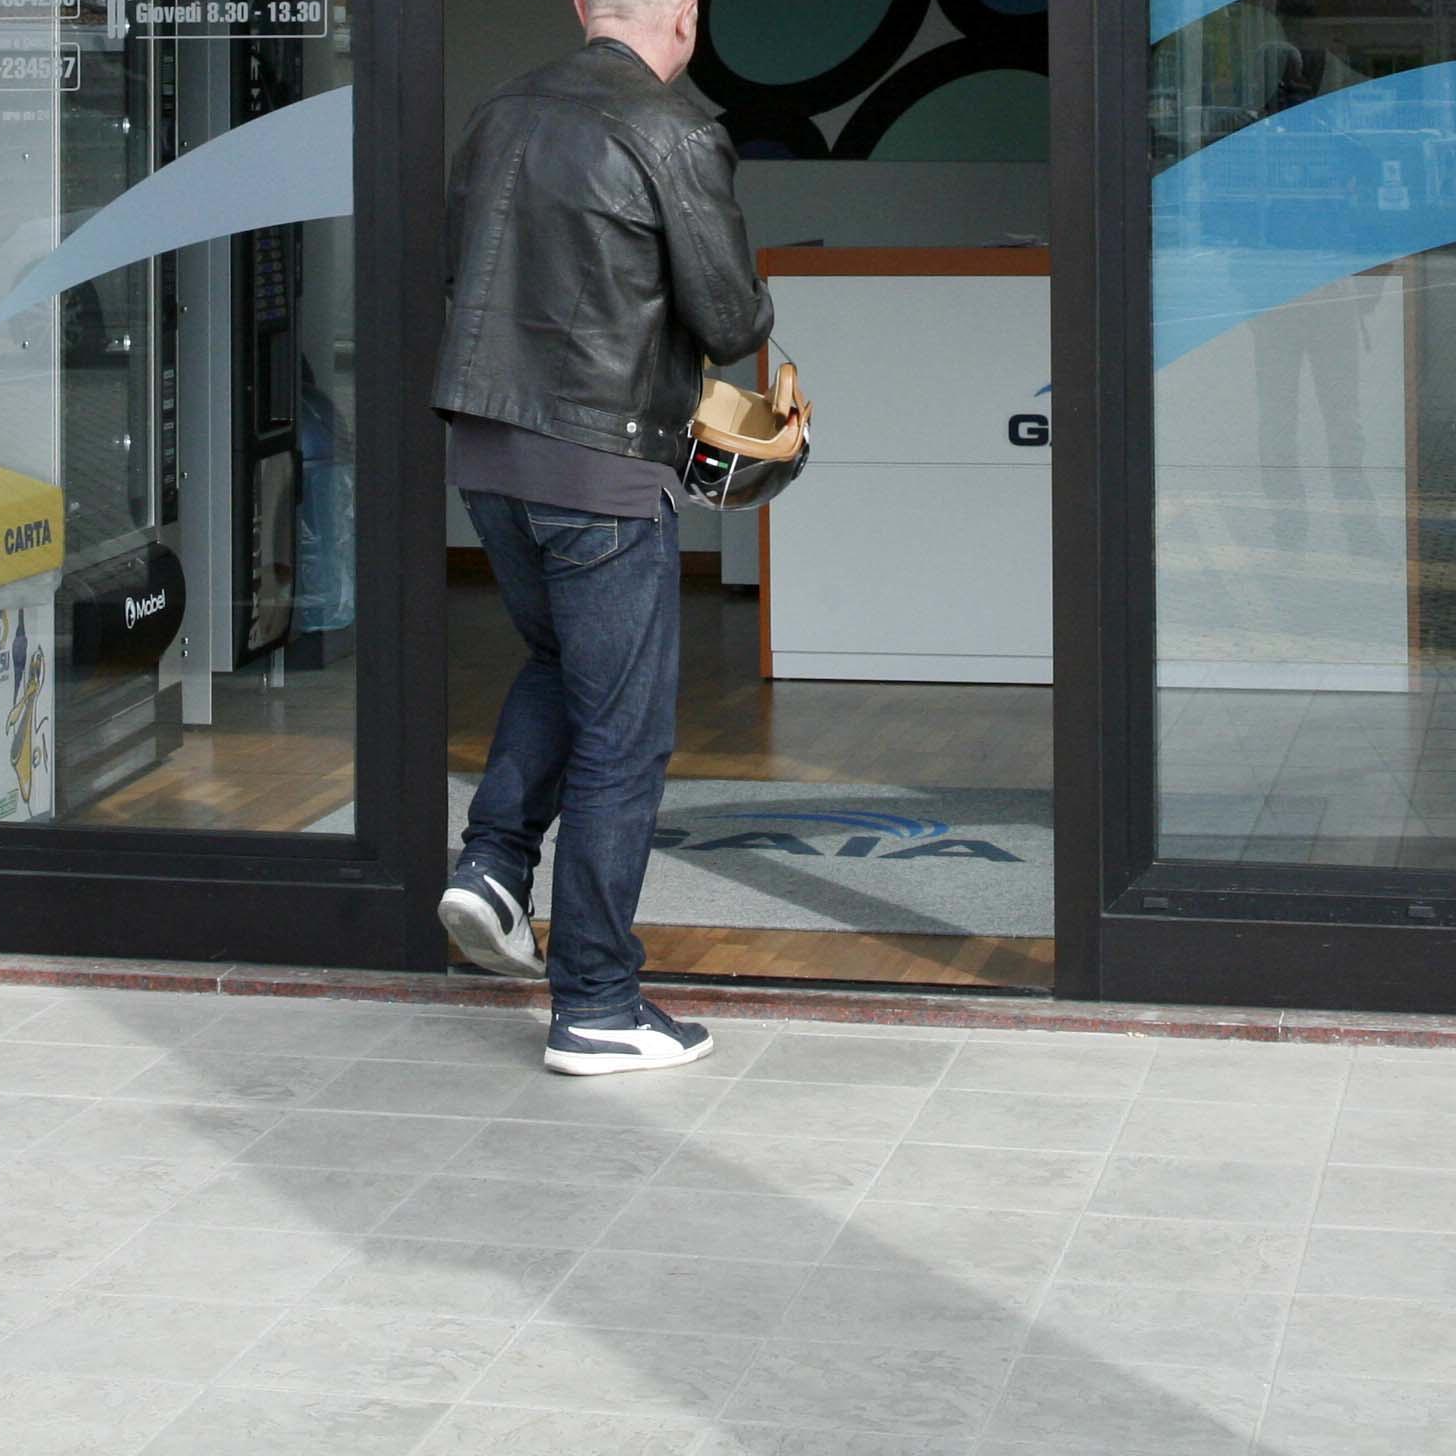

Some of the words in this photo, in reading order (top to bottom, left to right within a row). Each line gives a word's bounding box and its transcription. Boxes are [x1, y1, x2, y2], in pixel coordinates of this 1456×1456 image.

[136, 2, 201, 23] Giovedì
[206, 1, 249, 23] 8.30
[267, 0, 321, 23] 13.30
[4, 519, 52, 555] CARTA
[651, 824, 1026, 863] AIA
